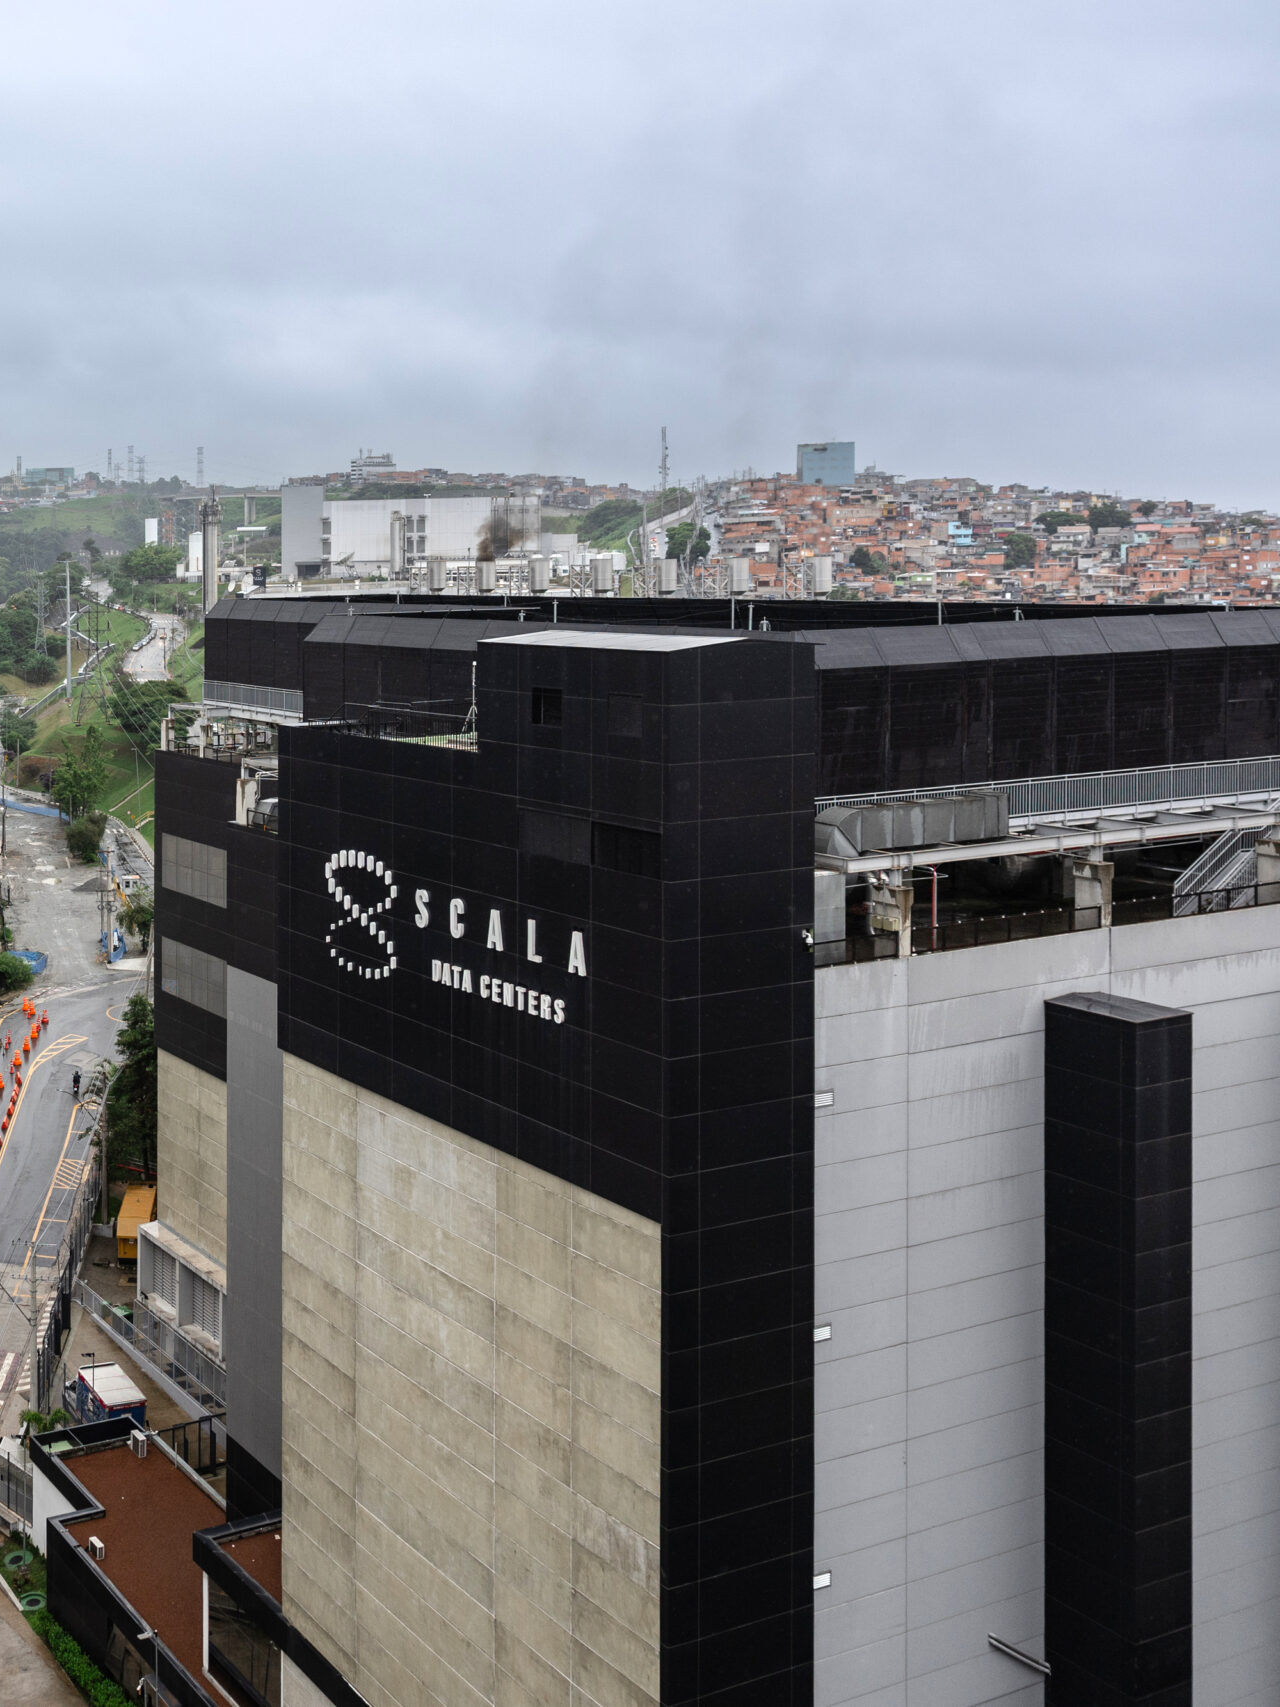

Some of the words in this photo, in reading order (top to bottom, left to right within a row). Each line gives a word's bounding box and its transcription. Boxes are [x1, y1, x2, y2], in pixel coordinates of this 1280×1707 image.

[414, 888, 587, 977] SCALA
[431, 959, 473, 993] DATA
[479, 974, 566, 1024] CENTERS
